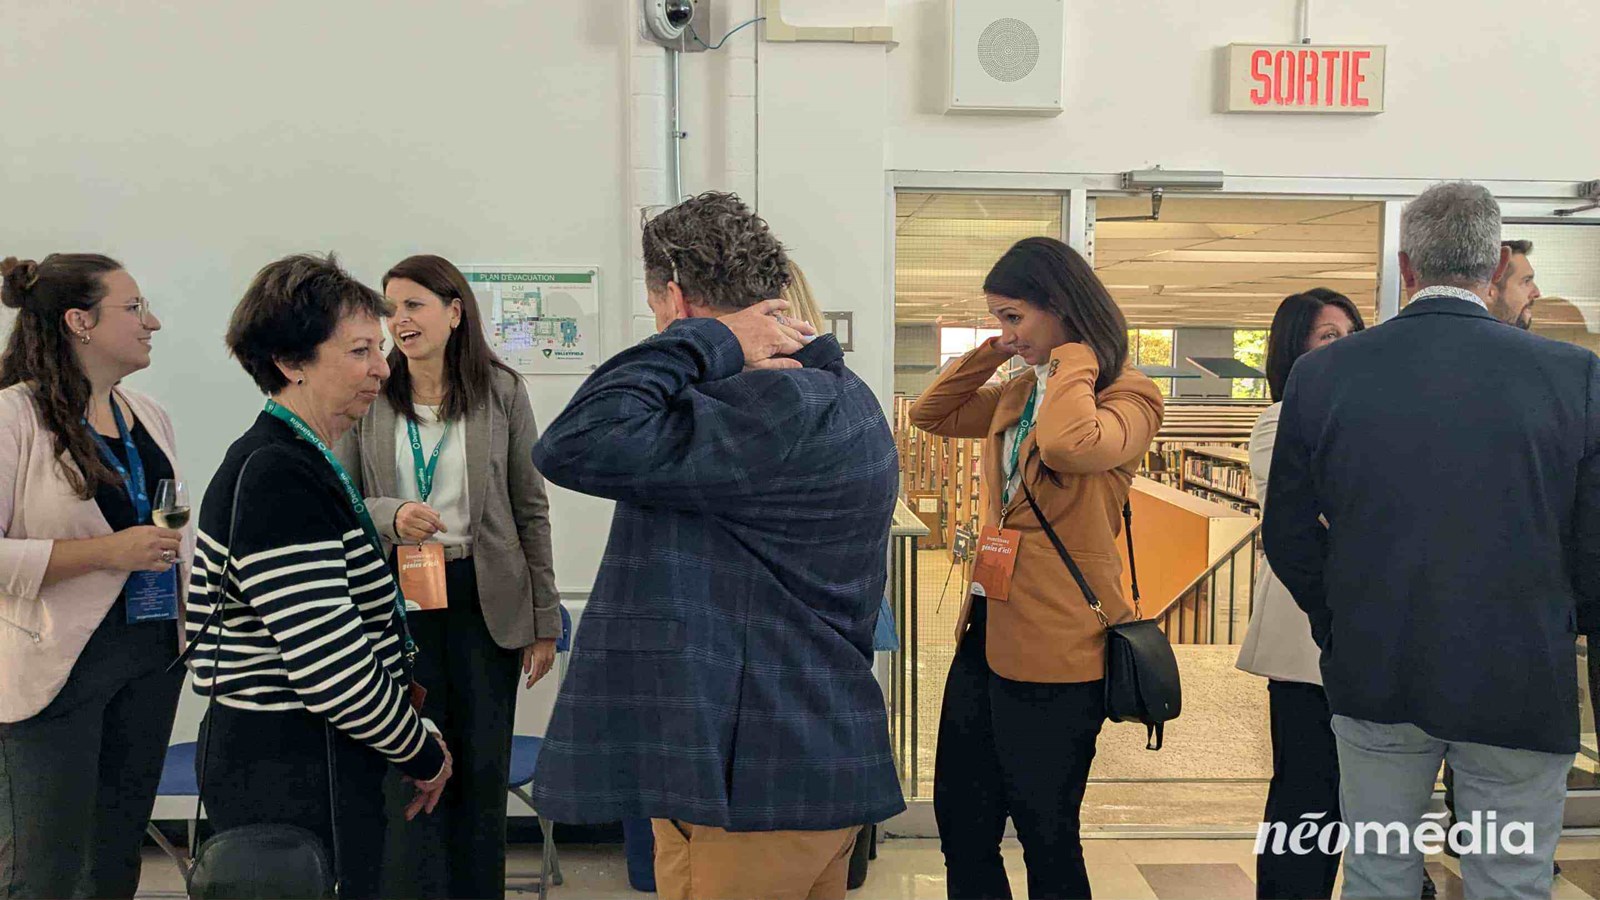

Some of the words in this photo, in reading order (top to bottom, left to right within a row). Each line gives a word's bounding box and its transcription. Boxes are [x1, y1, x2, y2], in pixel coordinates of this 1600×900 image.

[1250, 49, 1370, 107] SORTIE
[501, 273, 555, 281] D'ÉVACUATION
[289, 417, 319, 444] Desjardins
[340, 473, 359, 504] Desjardins
